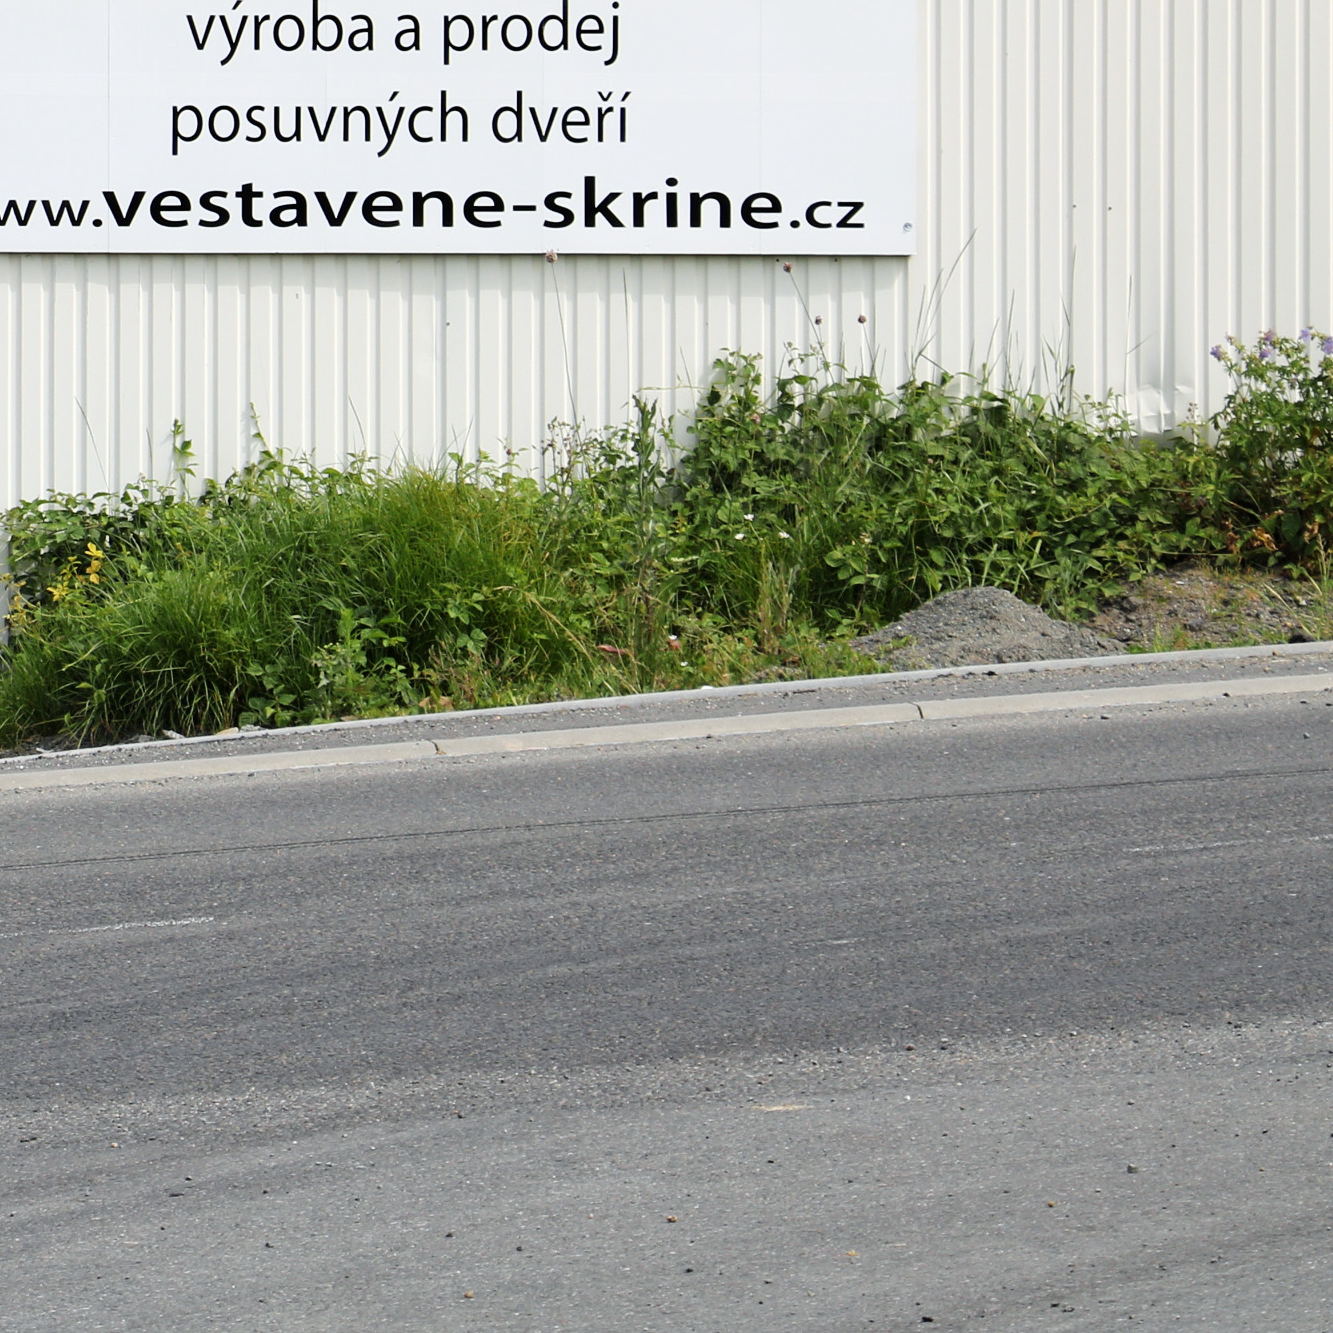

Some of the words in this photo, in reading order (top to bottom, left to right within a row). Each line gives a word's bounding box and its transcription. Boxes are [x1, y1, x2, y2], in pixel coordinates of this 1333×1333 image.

[394, 14, 420, 52] a
[172, 90, 469, 158] posuvných
[491, 90, 631, 144] dveří
